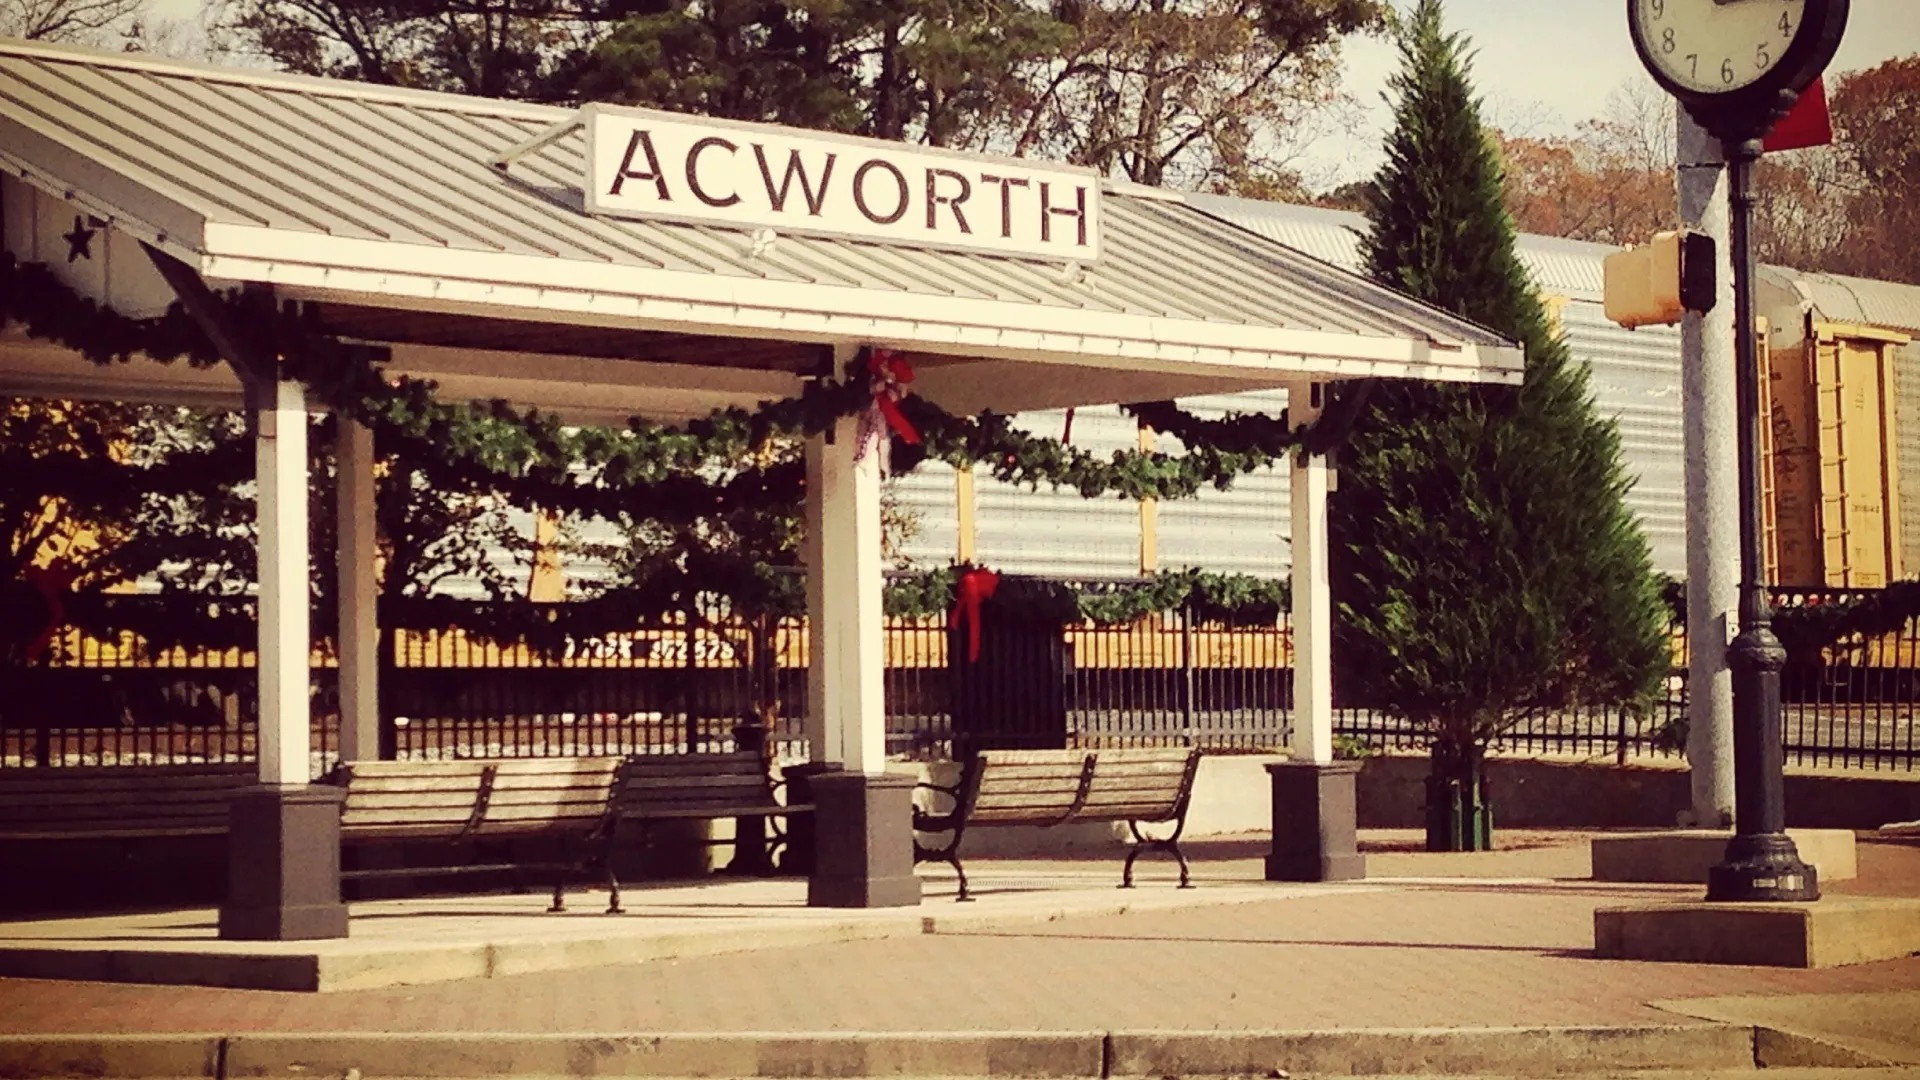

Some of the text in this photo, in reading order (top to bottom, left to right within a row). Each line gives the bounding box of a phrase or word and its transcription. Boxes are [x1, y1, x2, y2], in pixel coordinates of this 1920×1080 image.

[1651, 0, 1664, 20] 9
[1777, 11, 1792, 38] 4
[1662, 27, 1675, 54] 8
[1686, 54, 1698, 78] 7
[1755, 42, 1769, 69] 5
[1720, 58, 1734, 84] 6
[605, 129, 1089, 247] ACWORTH
